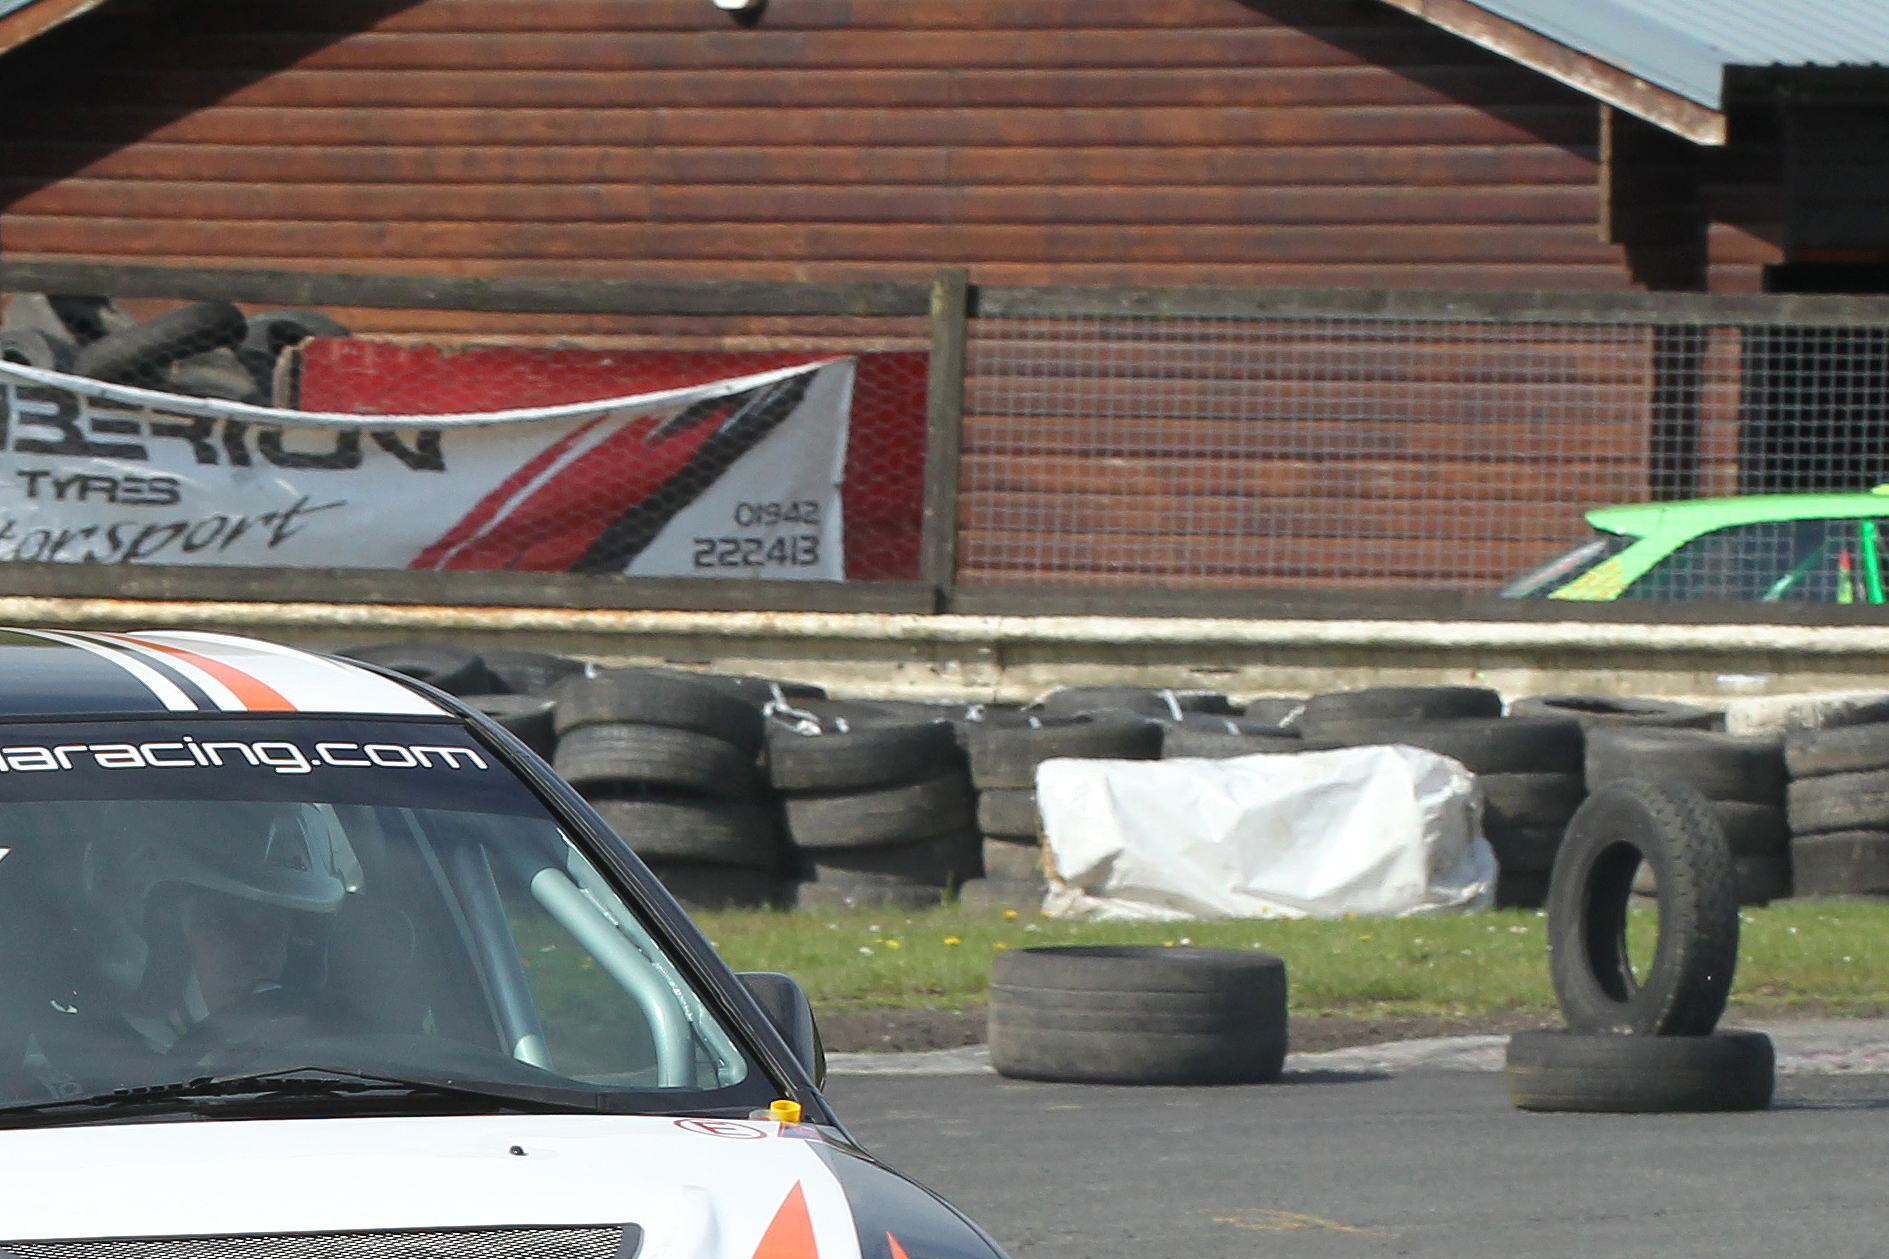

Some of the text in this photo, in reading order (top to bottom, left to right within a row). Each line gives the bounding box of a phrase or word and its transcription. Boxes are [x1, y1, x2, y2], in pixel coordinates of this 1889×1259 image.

[17, 468, 181, 505] TYRES
[734, 500, 821, 527] 01942
[693, 535, 821, 568] 222413
